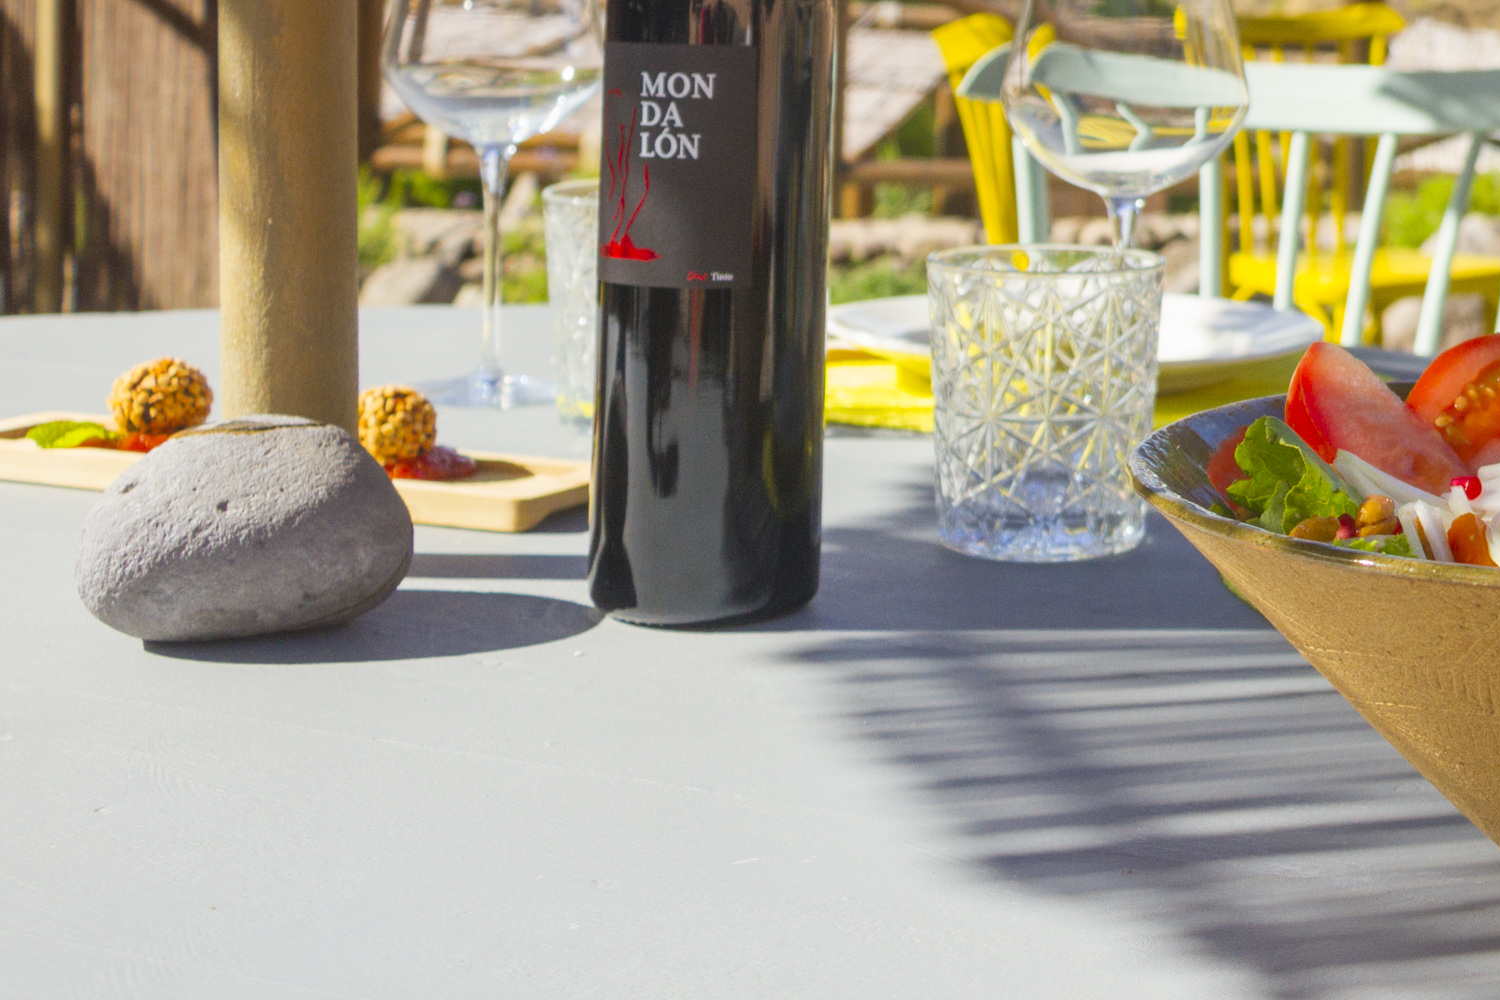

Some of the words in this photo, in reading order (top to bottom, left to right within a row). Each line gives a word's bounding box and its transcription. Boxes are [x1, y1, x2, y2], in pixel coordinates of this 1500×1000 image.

[640, 71, 716, 99] MON
[640, 100, 683, 127] DA
[639, 127, 701, 159] LÓN
[711, 271, 733, 281] Tinto
